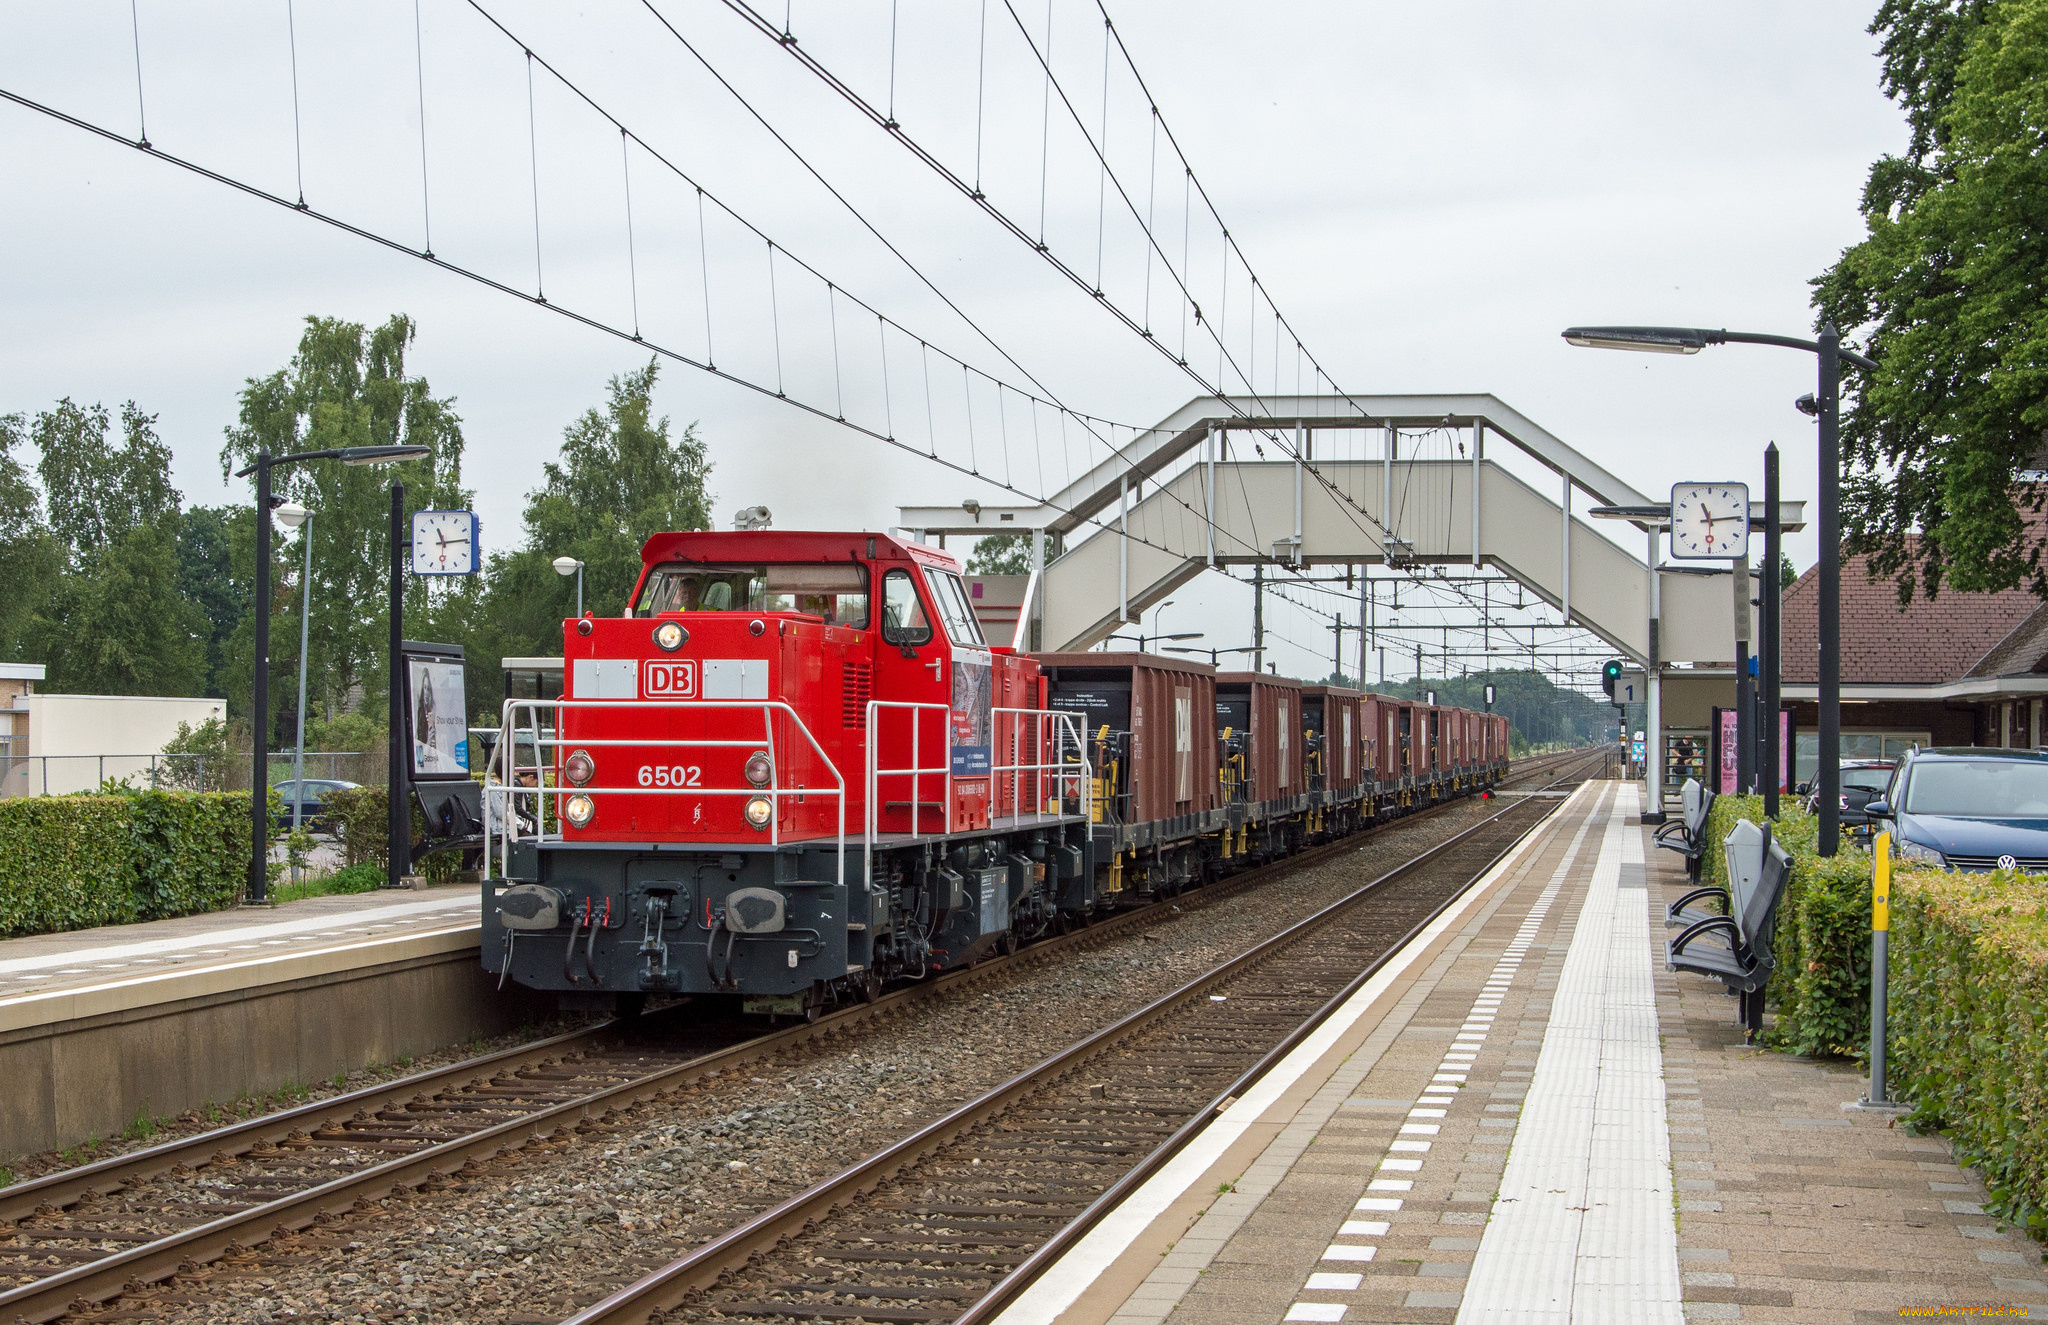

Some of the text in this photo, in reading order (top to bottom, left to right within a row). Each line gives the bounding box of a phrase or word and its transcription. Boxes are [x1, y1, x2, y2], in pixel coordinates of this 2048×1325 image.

[651, 666, 690, 692] DB
[1625, 684, 1633, 701] 1
[637, 765, 702, 787] 6502
